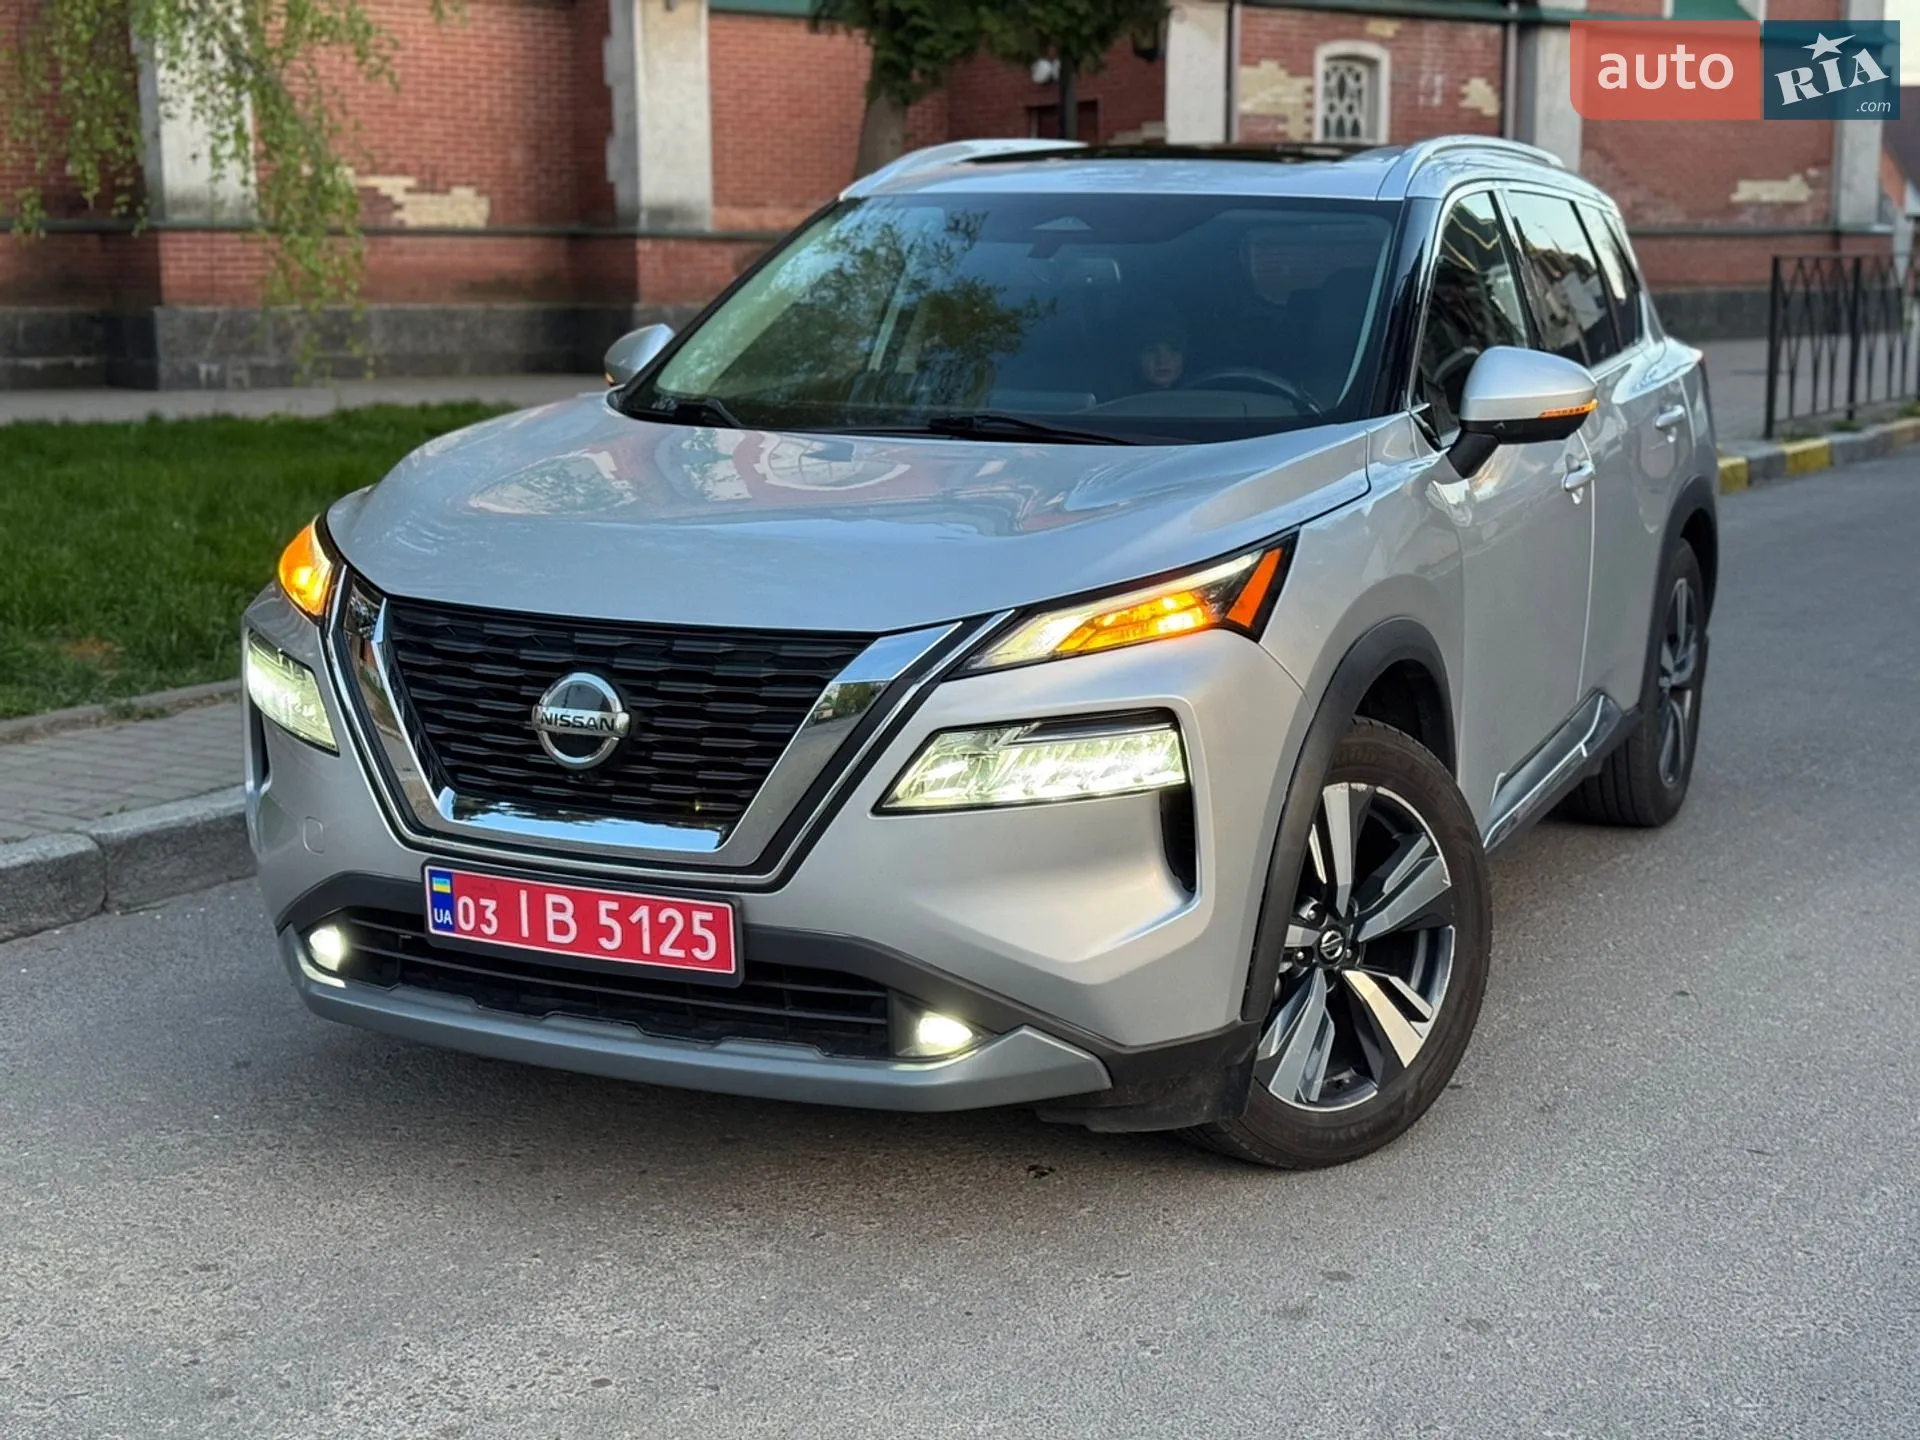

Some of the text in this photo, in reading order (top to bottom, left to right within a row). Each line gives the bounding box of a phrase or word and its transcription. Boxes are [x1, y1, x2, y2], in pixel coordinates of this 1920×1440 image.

[540, 711, 615, 732] NISSAN
[434, 907, 453, 926] UA
[457, 895, 499, 935] 03
[597, 900, 718, 961] 5125
